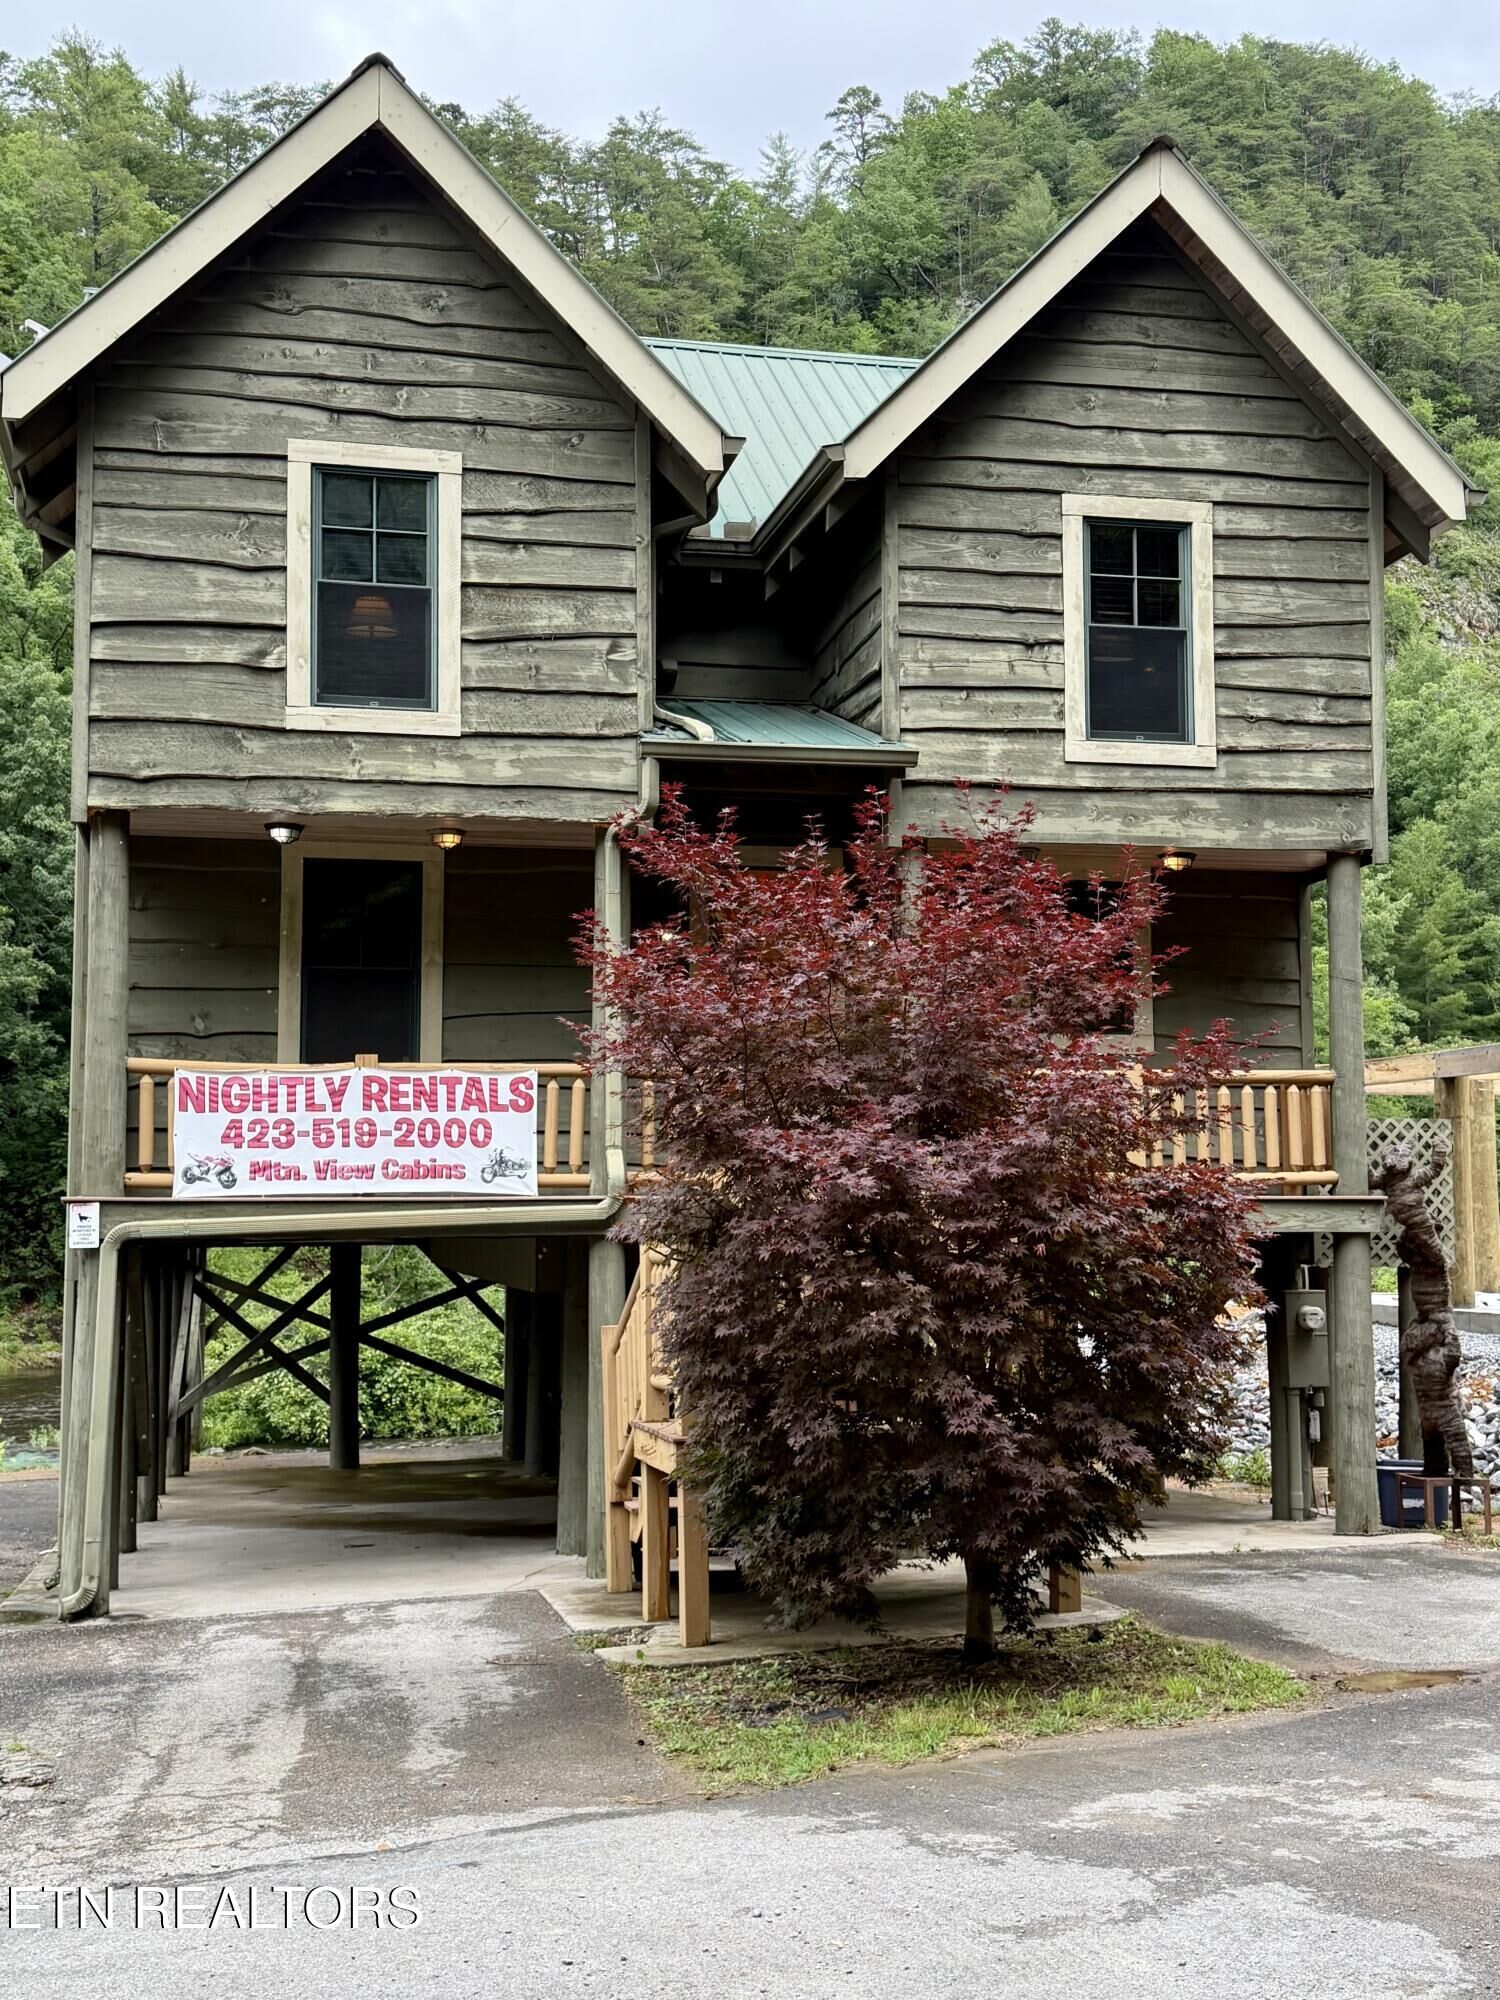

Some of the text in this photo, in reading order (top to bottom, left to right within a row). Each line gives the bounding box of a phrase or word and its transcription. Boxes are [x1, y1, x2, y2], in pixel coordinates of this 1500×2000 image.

[178, 1075, 534, 1113] NIGHTLY RENTALS
[220, 1117, 493, 1149] 423-519-2000
[248, 1157, 466, 1182] Mtn. View Cabins
